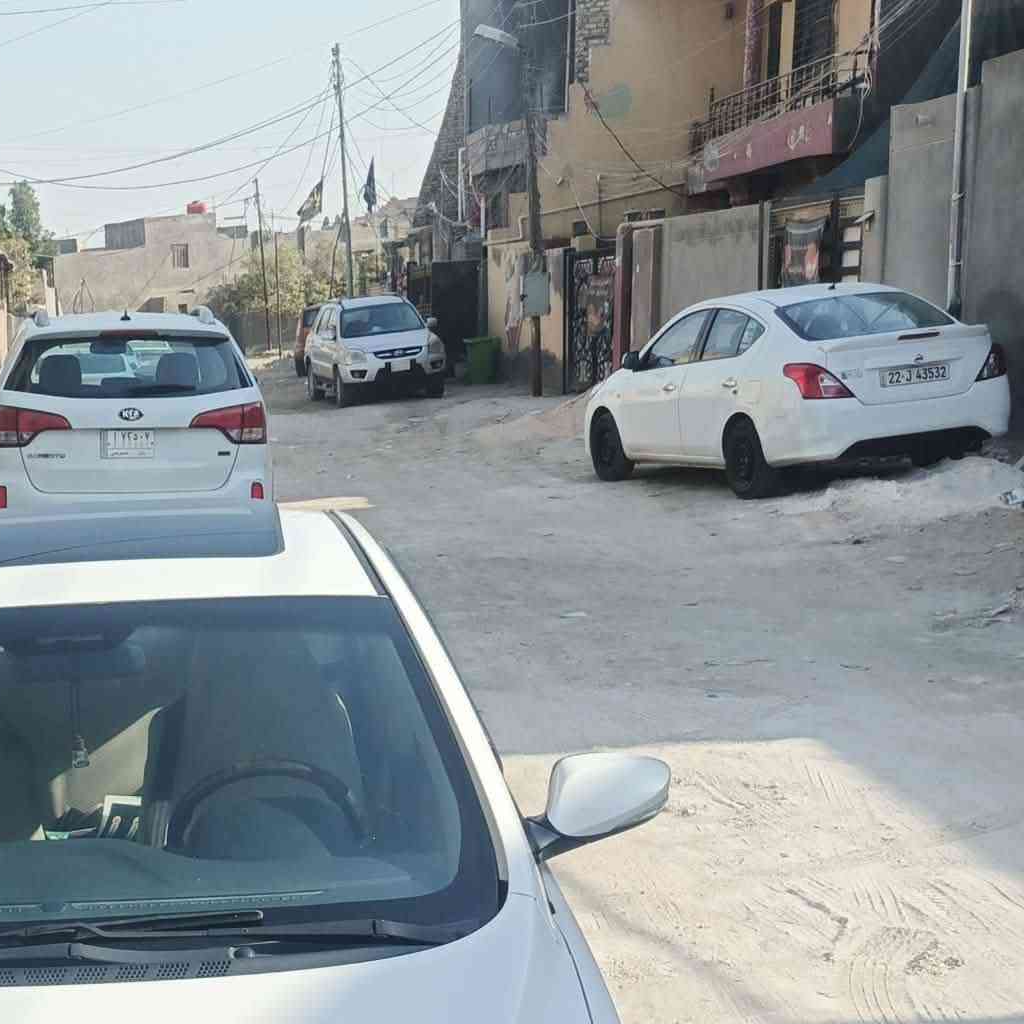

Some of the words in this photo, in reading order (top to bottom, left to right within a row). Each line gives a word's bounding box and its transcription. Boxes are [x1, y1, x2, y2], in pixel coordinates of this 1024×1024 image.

[888, 371, 902, 385] 22
[906, 369, 913, 383] J
[915, 366, 947, 381] 43532
